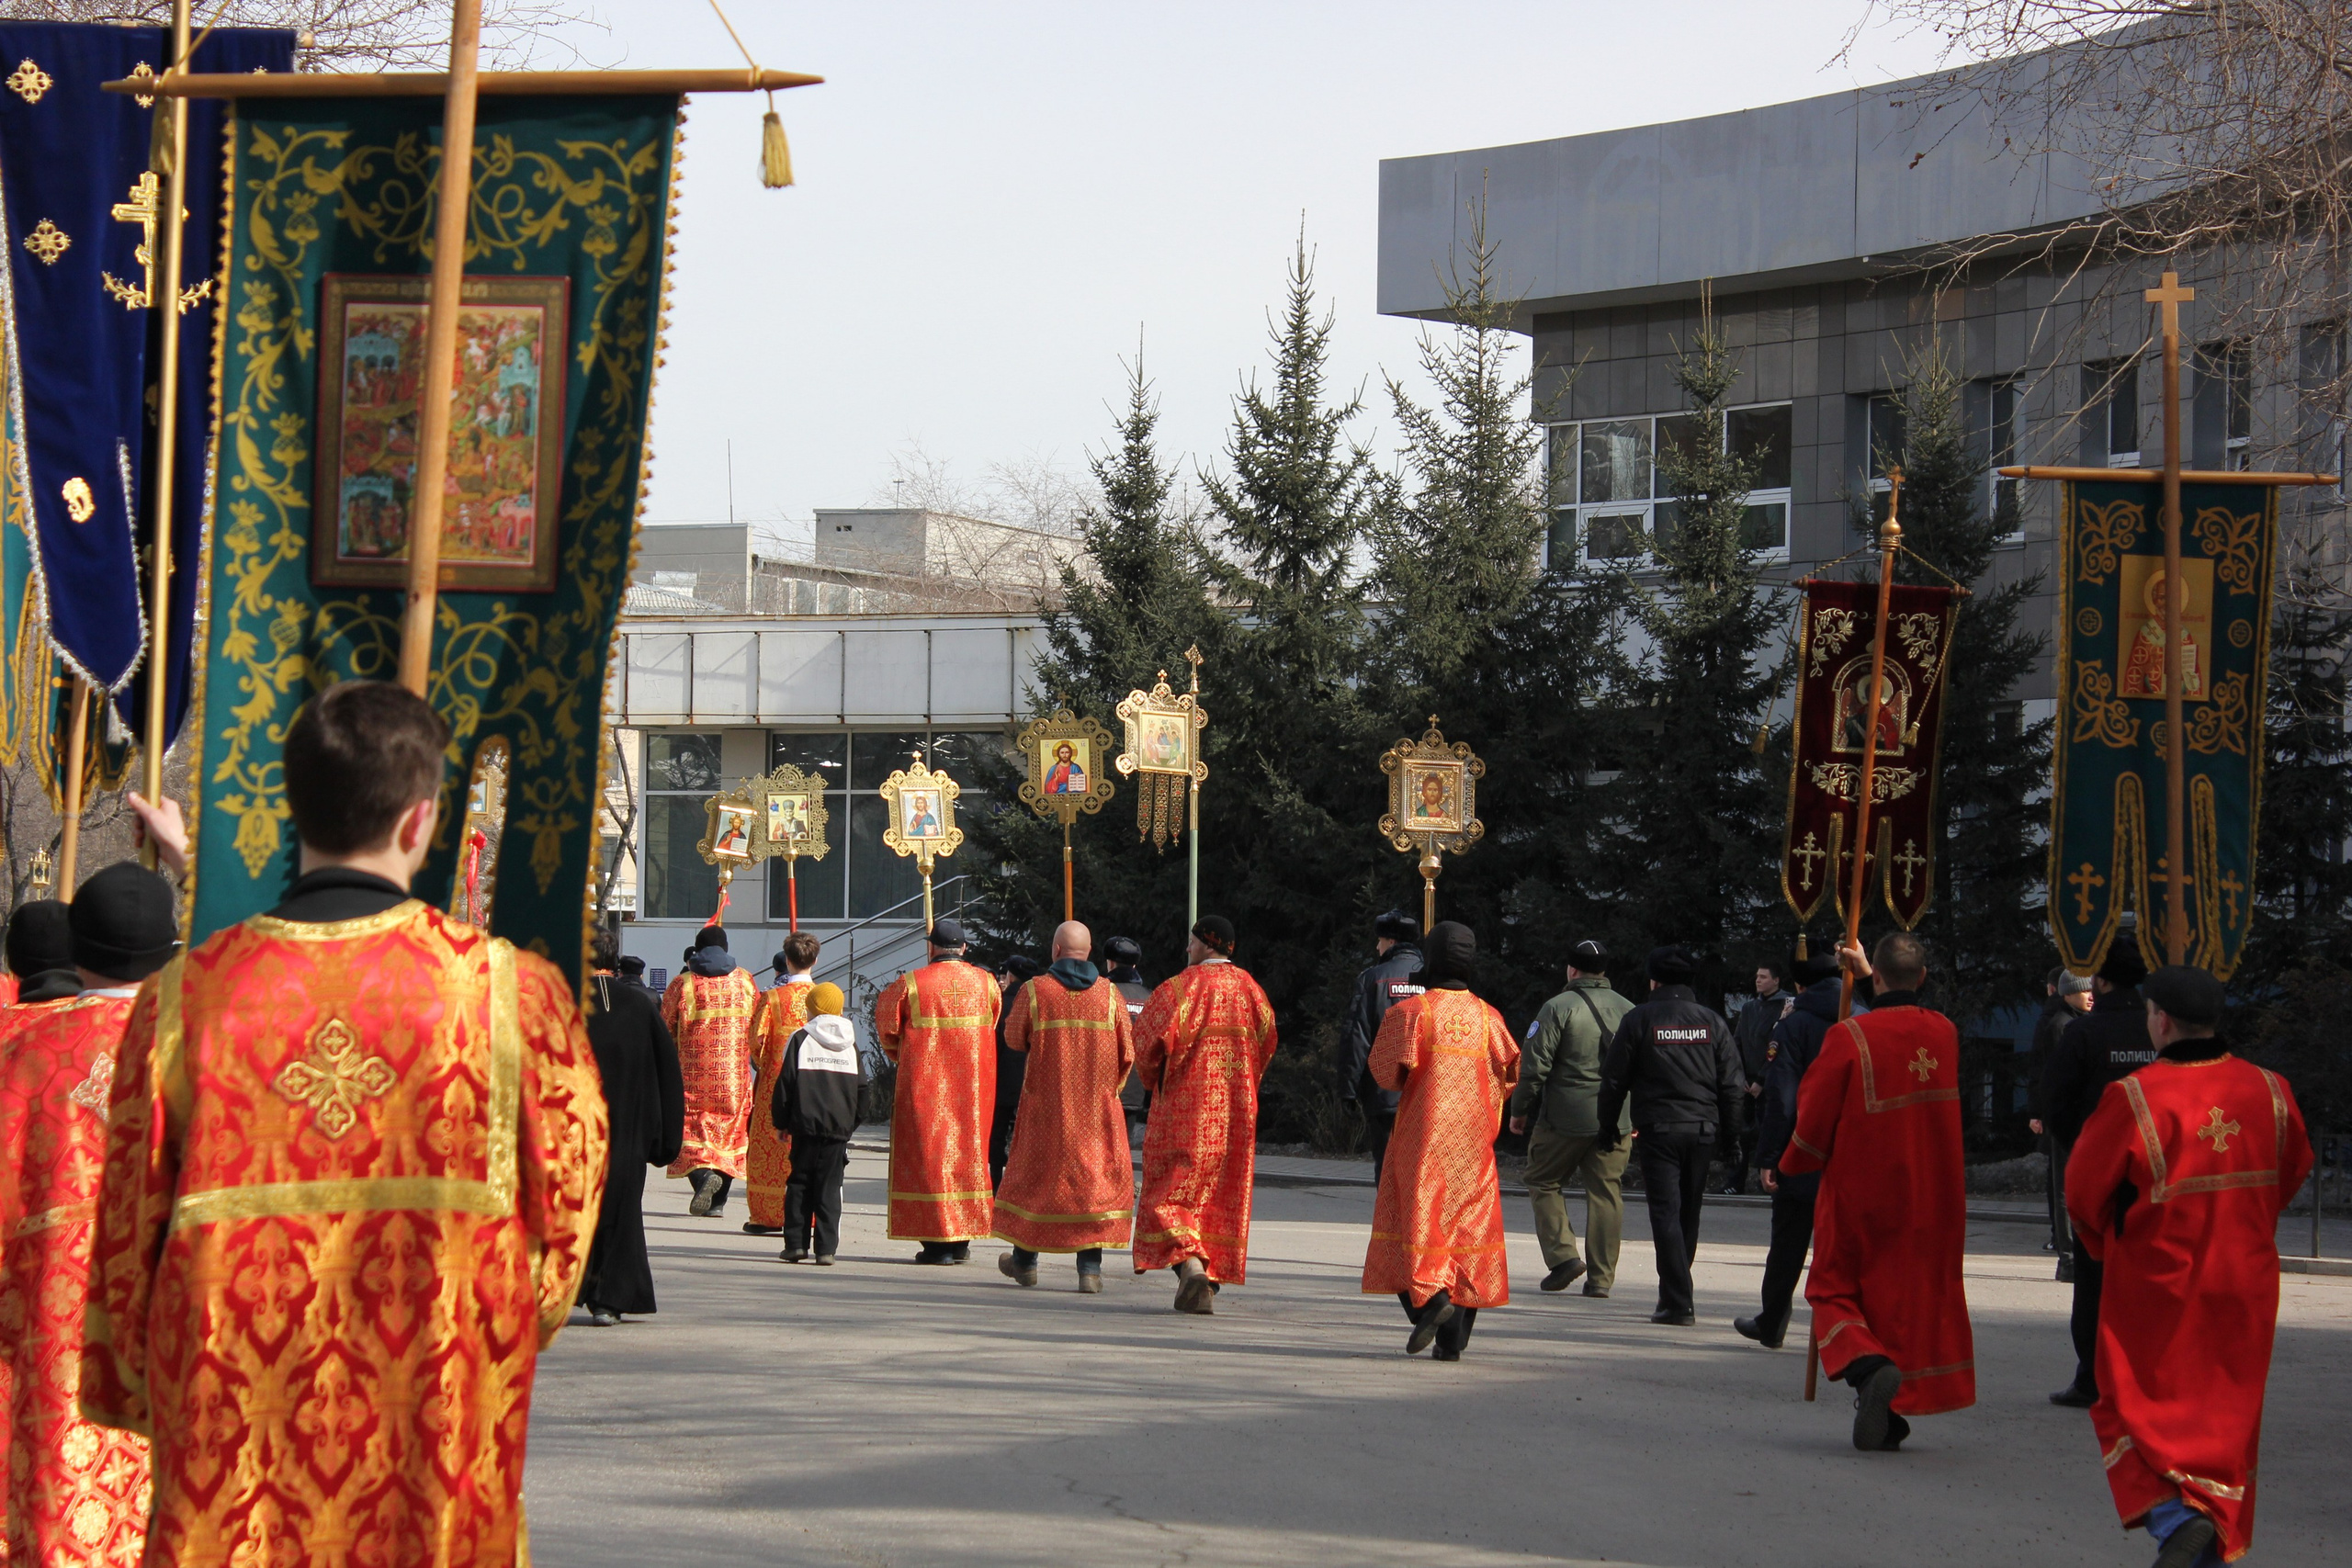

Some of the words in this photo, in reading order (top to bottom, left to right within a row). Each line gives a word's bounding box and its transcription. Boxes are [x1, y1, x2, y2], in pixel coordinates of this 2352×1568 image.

[1657, 1029, 1707, 1041] ПОЛИЦИЯ
[814, 1057, 849, 1066] PROGRESS
[2110, 1051, 2159, 1064] ПОЛИЦИ
